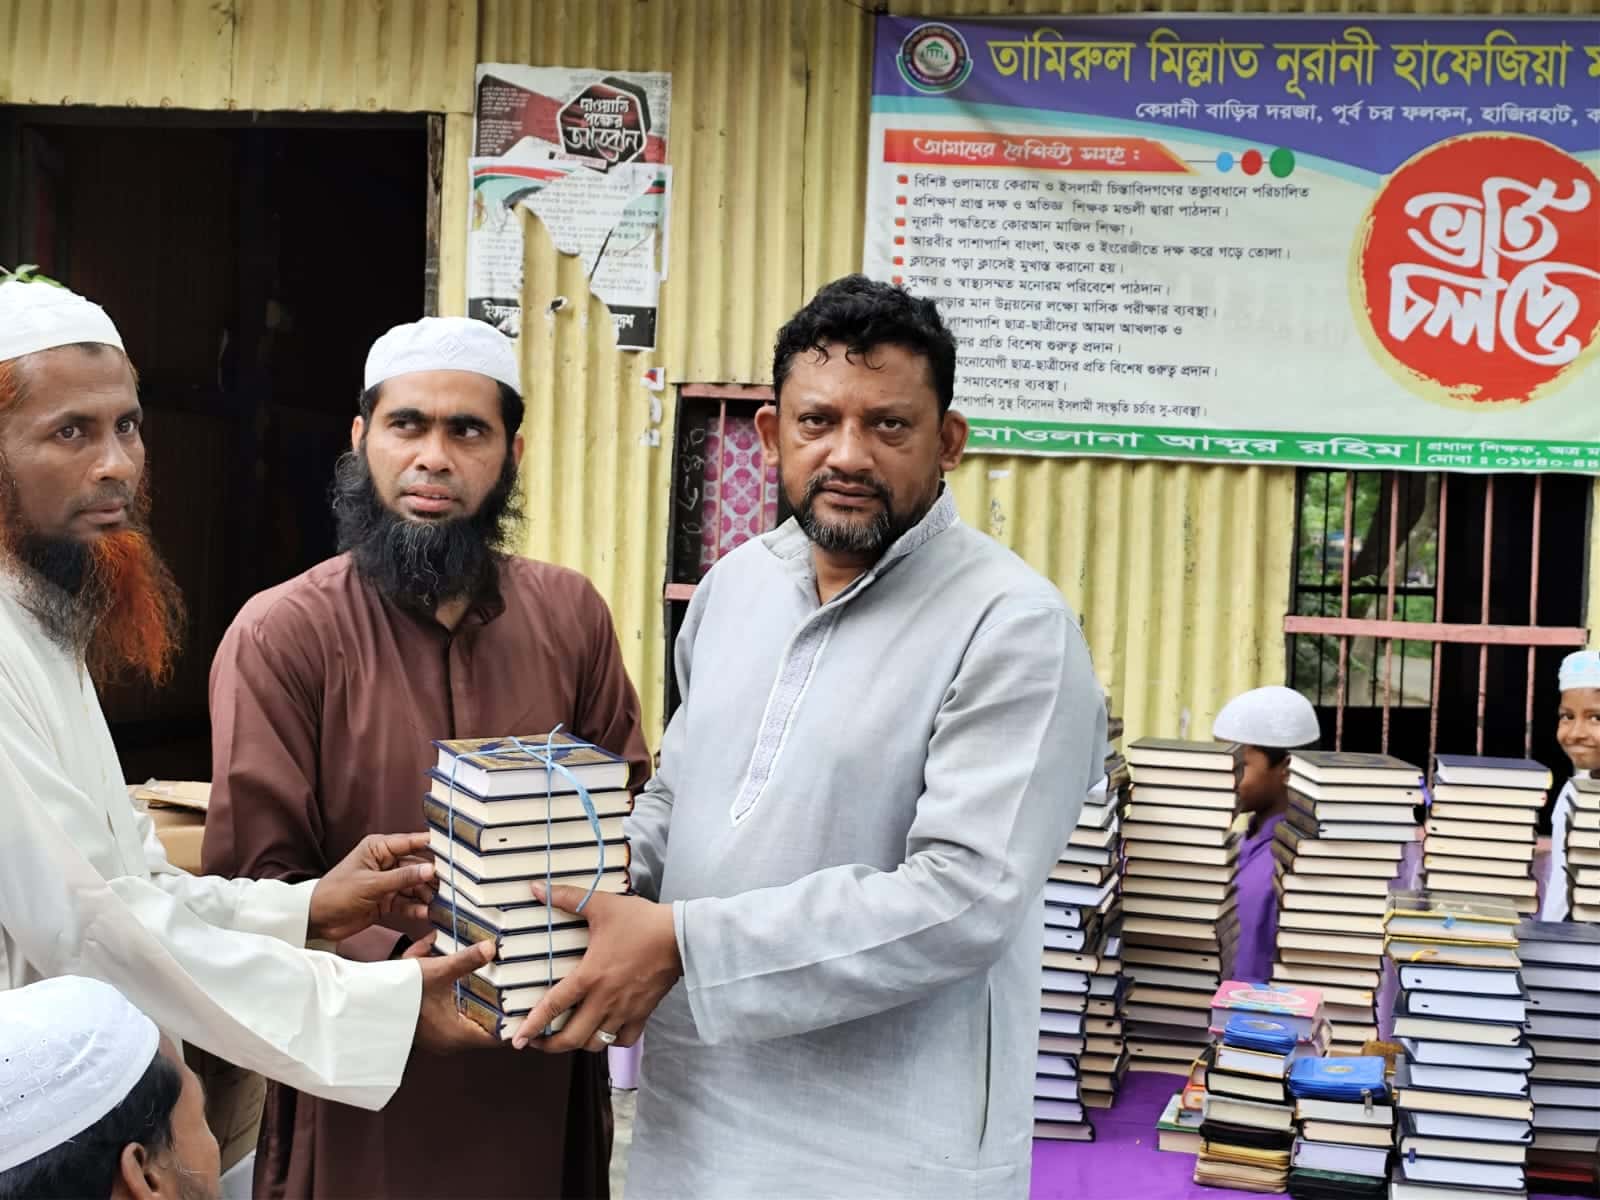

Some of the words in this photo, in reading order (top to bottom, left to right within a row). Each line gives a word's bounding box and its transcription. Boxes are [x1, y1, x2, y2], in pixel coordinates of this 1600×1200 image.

[987, 27, 1136, 82] তামিরুল
[1146, 27, 1264, 88] মিল্লাত
[1274, 26, 1380, 99] নূরানী
[1392, 29, 1573, 91] হাফেজিয়া
[580, 95, 629, 113] দাওয়াতি
[1136, 99, 1197, 119] কেরানী
[1206, 100, 1259, 121] বাড়ির
[1266, 102, 1322, 122] দরজা,
[1332, 100, 1364, 125] পূর্ব
[1368, 106, 1393, 121] চর
[1402, 105, 1472, 125] ফলকন,
[1481, 102, 1577, 126] হাজিরহাট,
[584, 111, 623, 128] পক্ষের
[914, 137, 997, 160] আমাদের
[1004, 139, 1072, 165] বৈশিষ্ট্য
[1080, 146, 1126, 165] সমূহ
[915, 174, 946, 187] বিশিষ্ট
[952, 178, 999, 190] ওলামায়ে
[1004, 180, 1039, 192] কেরাম
[1045, 182, 1052, 191] ও
[1059, 180, 1101, 194] ইসলামী
[1108, 181, 1183, 196] চিন্তাবিদগণের
[1252, 183, 1309, 198] পরিচালিত
[912, 194, 955, 208] প্রশিক্ষণ
[960, 198, 982, 208] প্রাপ্ত
[988, 199, 1007, 209] দক্ষ
[1013, 202, 1021, 210] ও
[1026, 197, 1062, 211] অভিজ্ঞ
[1073, 199, 1108, 213] শিক্ষক
[1151, 207, 1173, 217] দ্বারা
[912, 213, 942, 230] নূরানী
[948, 216, 996, 230] পদ্ধতিতে
[1002, 221, 1050, 232] কোরআন
[1056, 218, 1090, 233] মাজিদ
[1404, 176, 1591, 278] ভর্তি
[911, 234, 952, 248] আরবীর
[958, 236, 1009, 250] পাশাপাশি
[1015, 240, 1048, 253] বাংলা,
[1053, 242, 1080, 252] অংক
[1086, 243, 1095, 252] ও
[1100, 240, 1157, 256] ইংরেজীতে
[1163, 247, 1183, 256] দক্ষ
[1190, 247, 1213, 257] করে
[1219, 247, 1243, 260] গড়ে
[909, 255, 945, 268] ক্লাসের
[952, 258, 973, 271] পড়া
[978, 257, 1015, 271] ক্লাসেই
[1056, 261, 1094, 273] করানো
[908, 276, 936, 287] সুন্দর
[944, 279, 952, 287] ও
[1019, 281, 1061, 291] মনোরম
[1066, 278, 1114, 294] পরিবেশে
[970, 298, 990, 309] মান
[995, 297, 1041, 311] উন্নয়নের
[1047, 301, 1077, 312] লক্ষ্যে
[1083, 300, 1118, 313] মাসিক
[1124, 300, 1168, 315] পরীক্ষার
[1389, 262, 1600, 366] চলছে
[1005, 318, 1077, 332] ছাত্র-ছাত্রীদের
[1083, 322, 1114, 333] আমল
[1120, 323, 1168, 336] আখলাক
[1173, 327, 1182, 335] ও
[979, 335, 1002, 348] প্রতি
[1008, 337, 1041, 350] বিশেষ
[1047, 342, 1078, 355] গুরুত্ব
[1011, 357, 1079, 371] ছাত্র-ছাত্রীদের
[1083, 358, 1105, 373] প্রতি
[1110, 360, 1142, 374] বিশেষ
[1148, 365, 1177, 378] গুরুত্ব
[963, 377, 1019, 389] সমাবেশের
[1017, 395, 1053, 409] বিনোদন
[1057, 398, 1092, 412] ইসলামী
[1097, 401, 1129, 416] সংস্কৃতি
[1133, 401, 1155, 414] চর্চার
[970, 426, 1145, 447] মাওলানা
[1157, 434, 1282, 455] আব্দুর
[1296, 437, 1409, 459] রহিম
[1427, 442, 1474, 453] প্রধান
[1480, 442, 1540, 456] শিক্ষক,
[1427, 453, 1471, 464] মোবা
